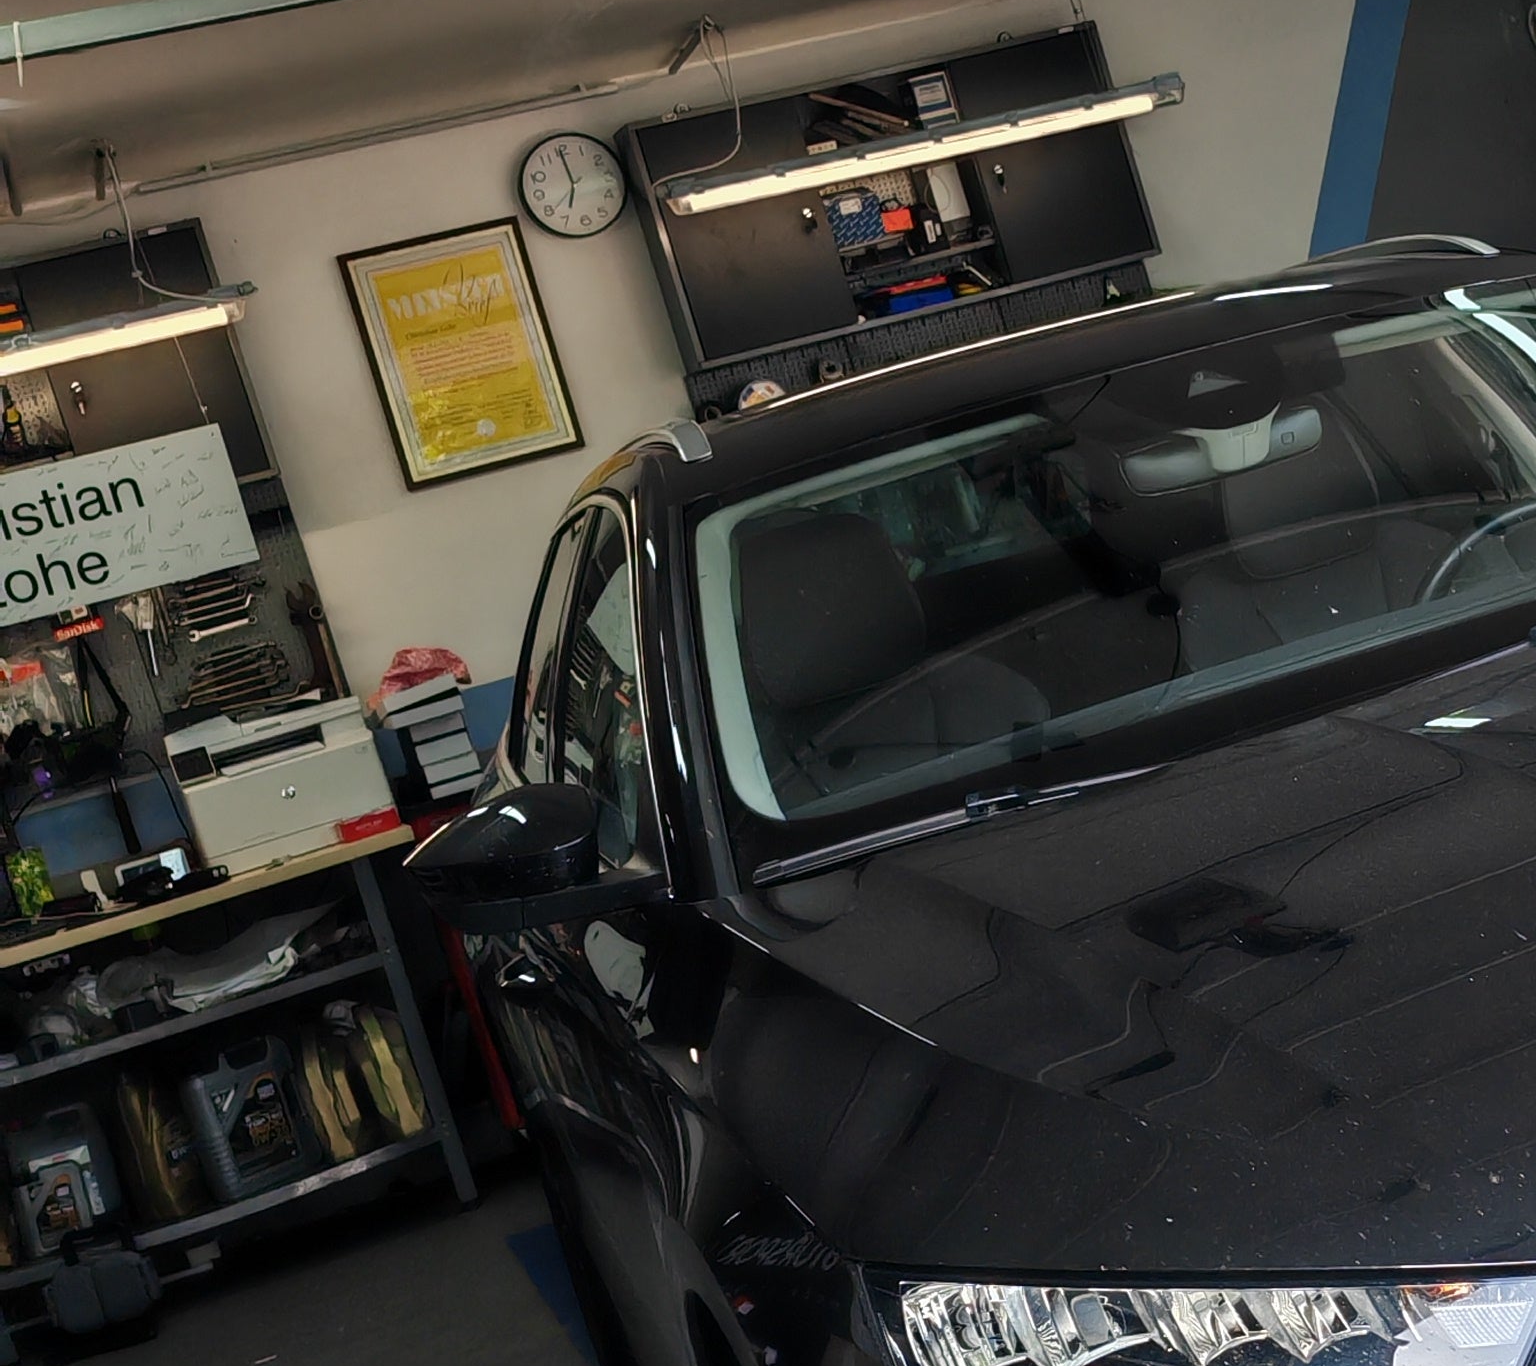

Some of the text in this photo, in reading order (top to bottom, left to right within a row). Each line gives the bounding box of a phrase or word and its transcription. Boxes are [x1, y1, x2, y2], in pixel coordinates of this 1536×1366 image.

[540, 153, 552, 166] 11
[593, 154, 604, 166] 2
[530, 171, 546, 184] 10
[544, 205, 555, 216] 8
[597, 207, 608, 218] 5
[561, 215, 569, 229] 7
